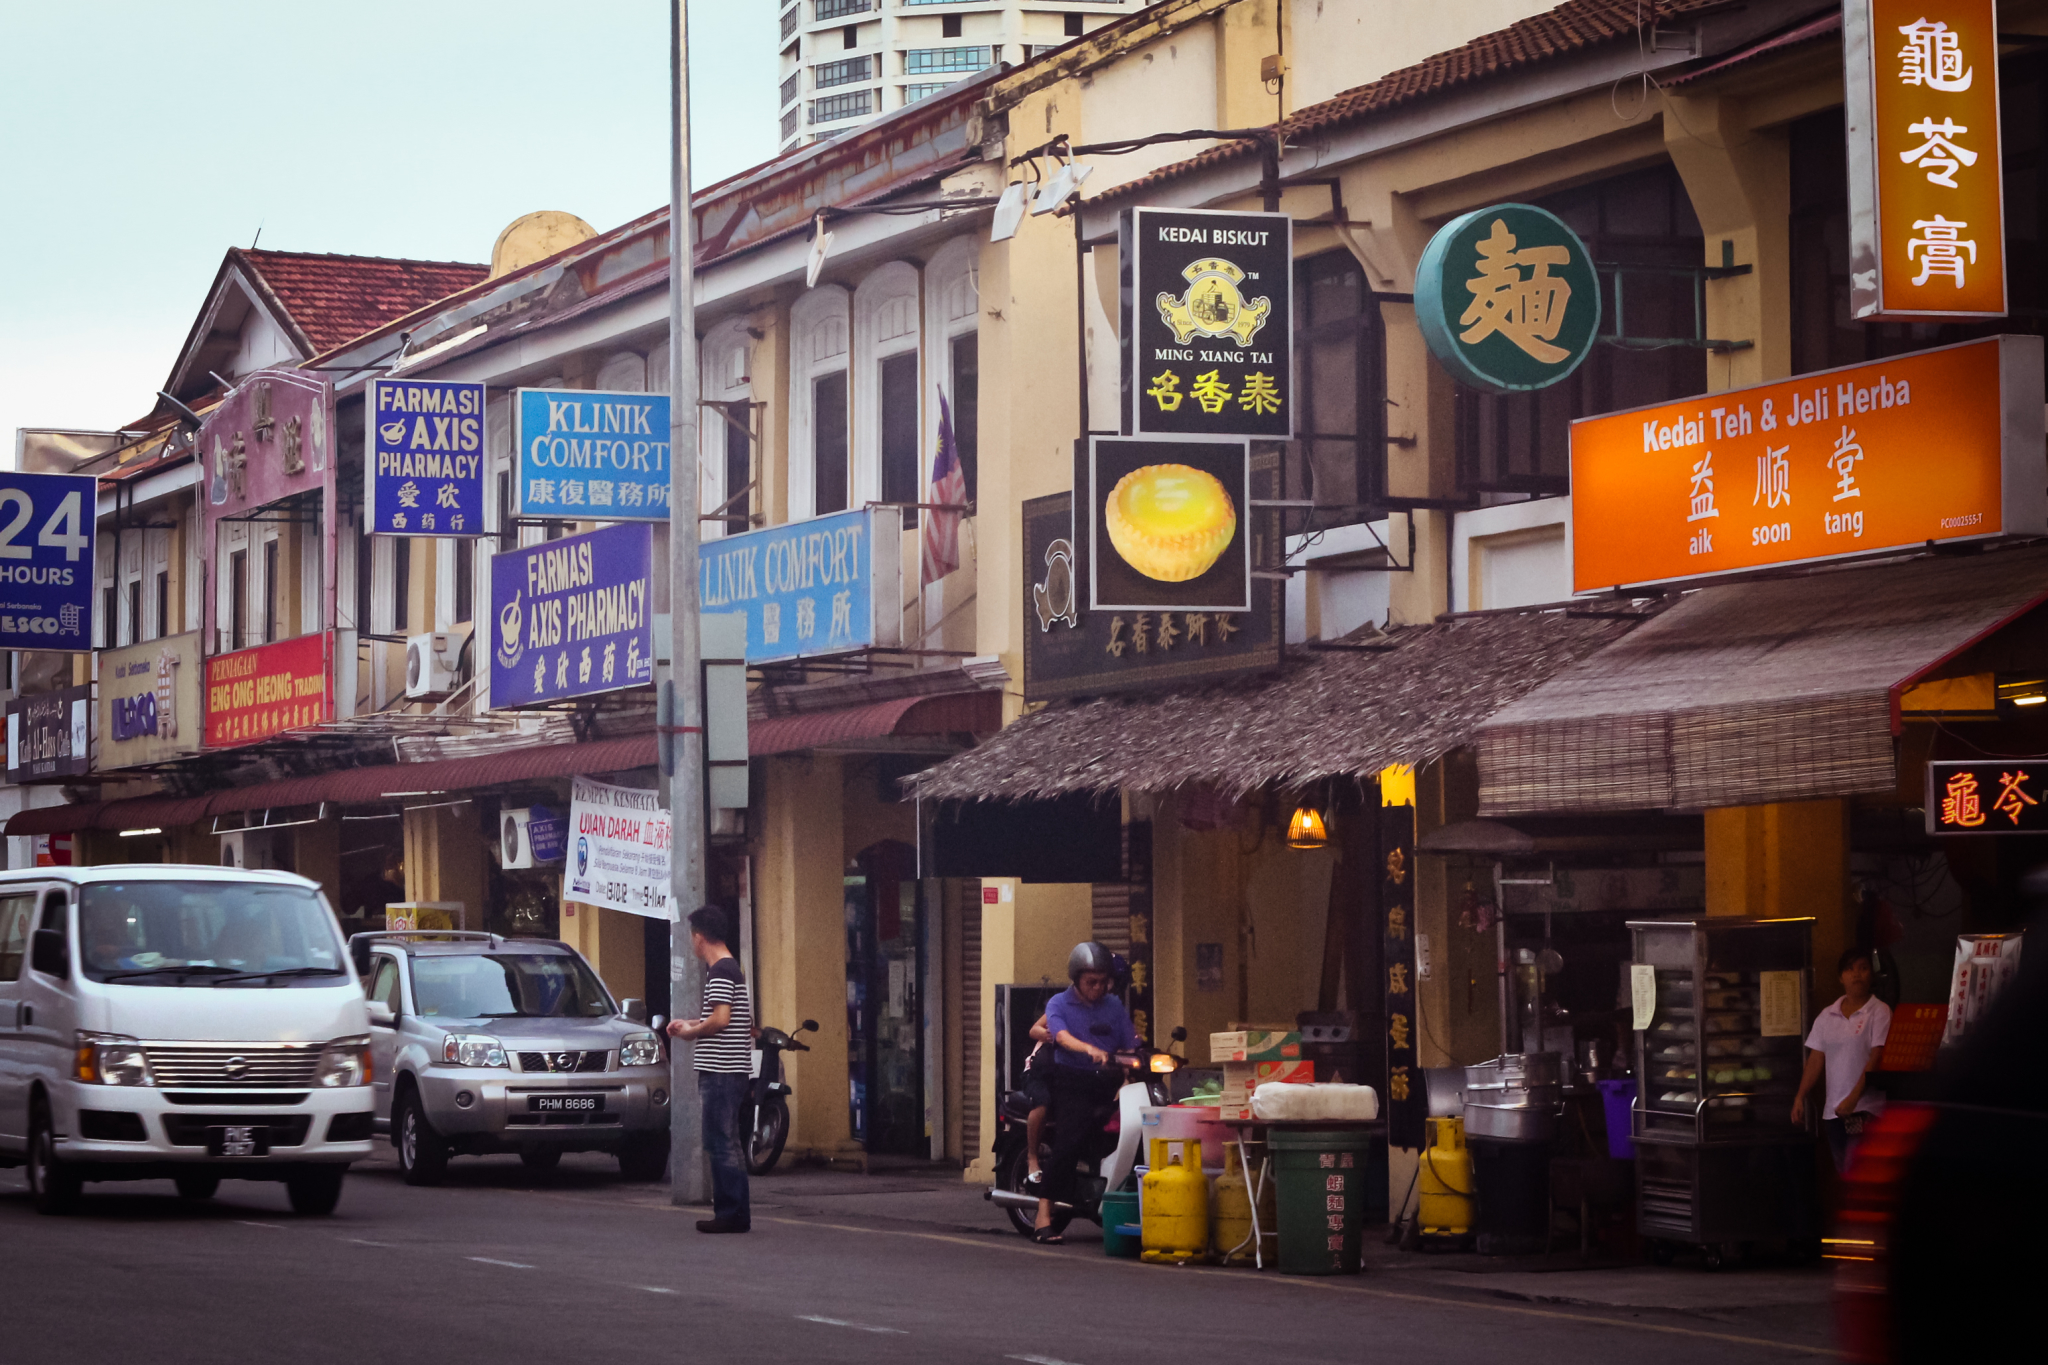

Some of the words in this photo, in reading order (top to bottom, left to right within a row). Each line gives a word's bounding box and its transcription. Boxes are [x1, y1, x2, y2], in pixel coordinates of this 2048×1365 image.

[1159, 227, 1207, 244] KEDAI
[1213, 229, 1269, 246] BISKUT
[1155, 349, 1194, 361] MING
[1200, 350, 1244, 363] XIANG
[1250, 352, 1273, 364] TAI
[379, 386, 480, 415] FARMASI
[1147, 369, 1282, 415] 名香泰
[546, 400, 652, 435] KLINIK
[1643, 410, 1705, 454] Kedai
[1711, 403, 1752, 440] Teh
[1760, 398, 1778, 432] &
[1786, 387, 1829, 427] Jeli
[1837, 375, 1911, 417] Herba
[409, 415, 479, 451] AXIS
[378, 451, 480, 479] PHARMACY
[530, 435, 669, 473] COMFORT
[0, 487, 89, 562] 24
[1689, 528, 1713, 555] aik
[1751, 522, 1791, 546] soon
[1824, 510, 1864, 538] tang
[0, 565, 74, 586] HOURS
[527, 541, 593, 598] FARMASI
[697, 546, 758, 608] LINIK
[764, 525, 863, 595] COMFORT
[528, 598, 562, 650] AXIS
[567, 578, 646, 643] PHARMACY
[211, 652, 258, 681] PERNIAGAAN
[210, 684, 231, 713] ENG
[232, 679, 254, 709] ONG
[256, 671, 292, 704] HEONG
[614, 789, 672, 815] KESIHATA
[1940, 769, 2048, 827] 龜苓
[580, 812, 607, 838] UJIAN
[607, 816, 641, 843] DARAH
[540, 1099, 562, 1110] PHM
[565, 1099, 595, 1110] 8686
